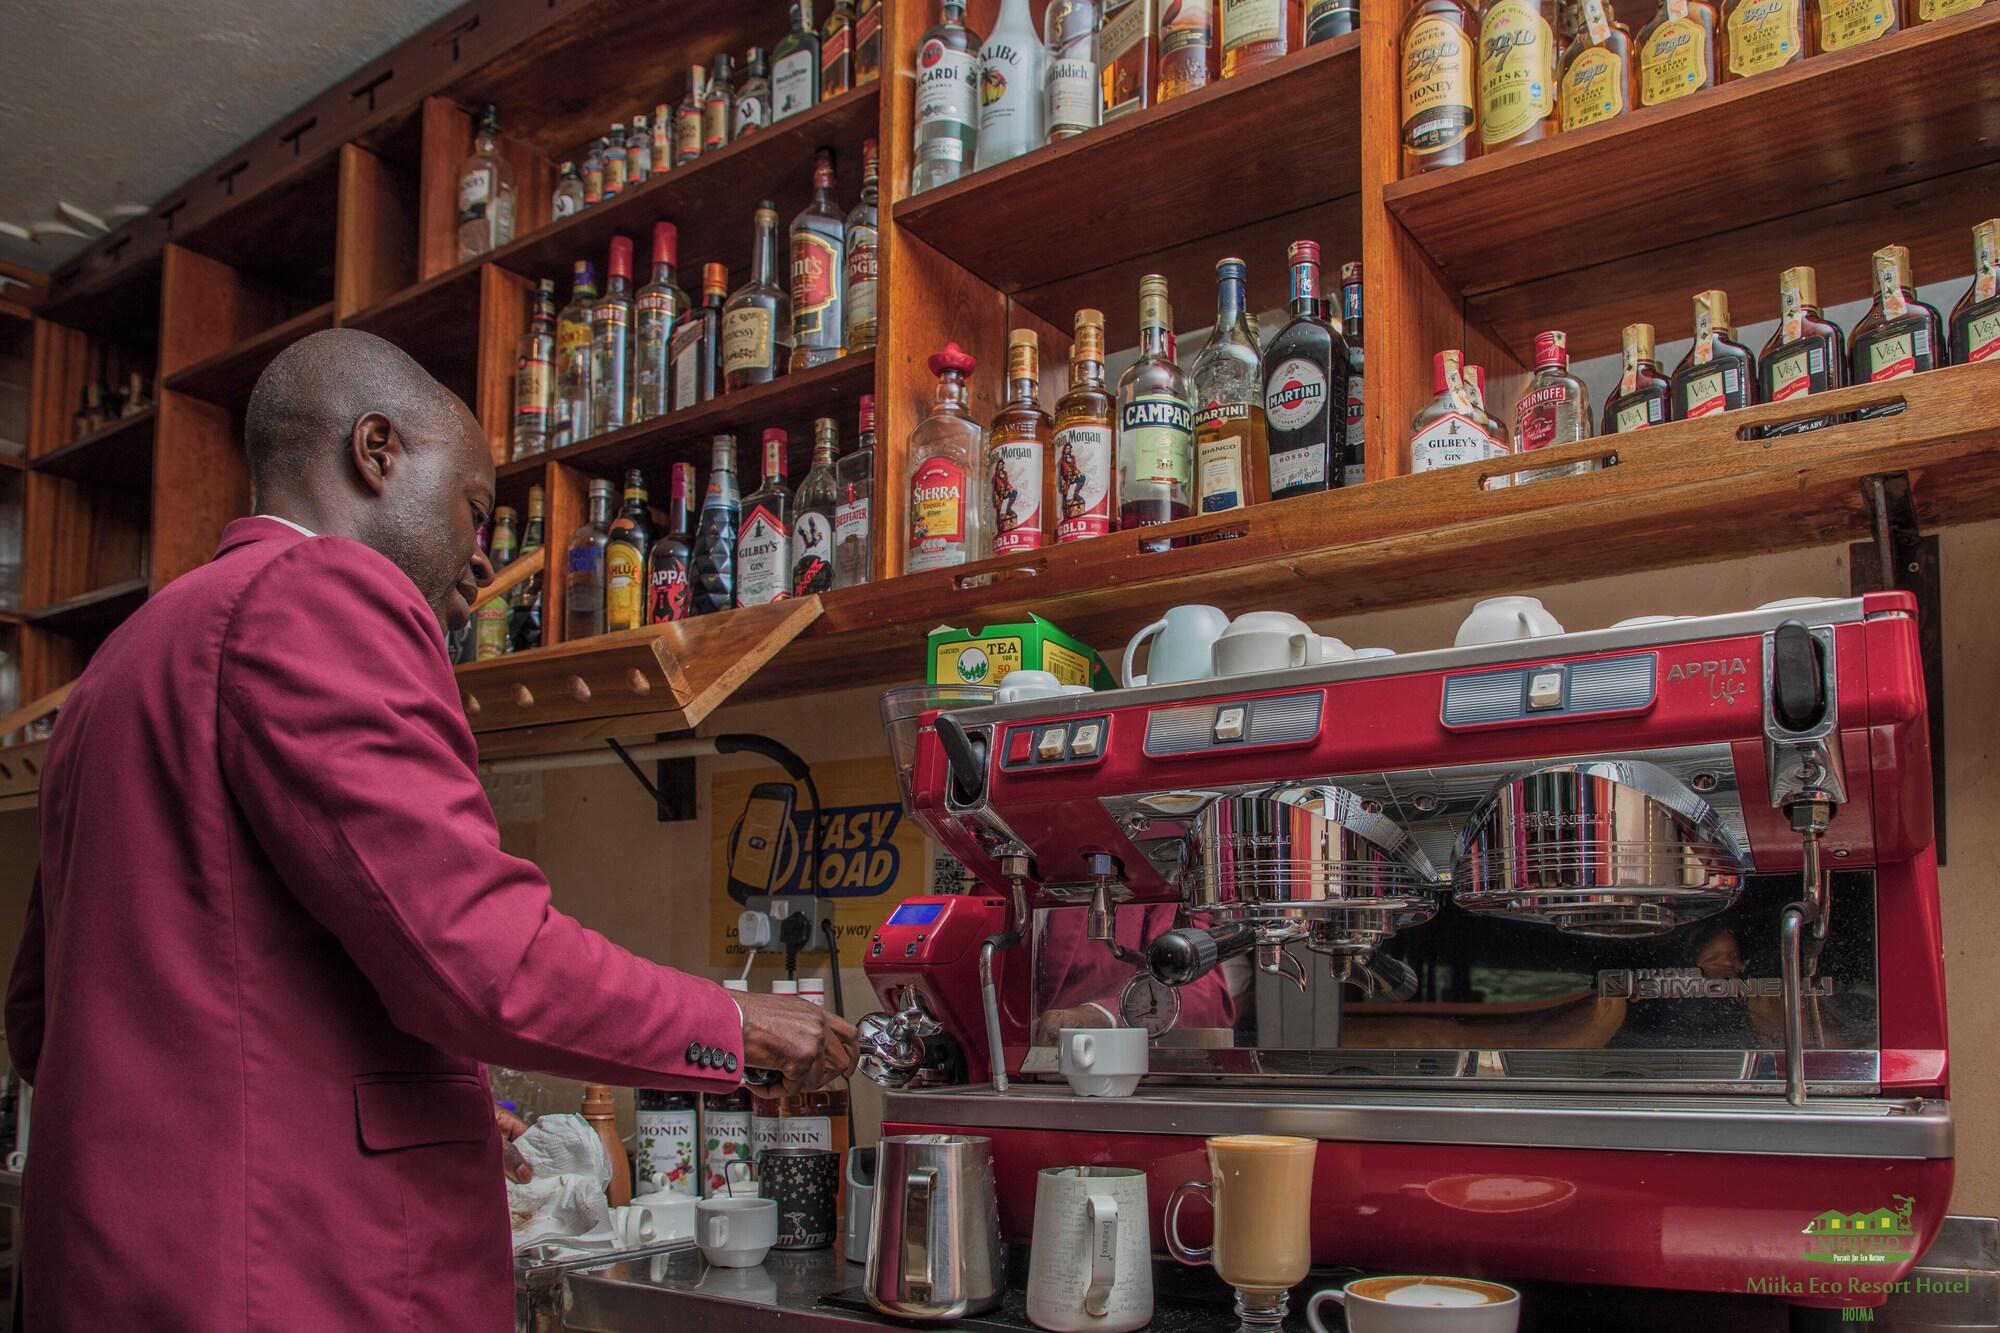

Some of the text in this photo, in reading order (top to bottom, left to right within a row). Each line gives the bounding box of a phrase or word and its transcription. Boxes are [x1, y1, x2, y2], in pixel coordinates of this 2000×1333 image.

[1482, 29, 1537, 65] BOND
[1483, 70, 1530, 92] WHISKY
[1410, 80, 1453, 104] HONEY
[1876, 341, 1906, 360] V&A
[1777, 360, 1802, 379] V&A
[1270, 384, 1320, 408] MARTINI
[1691, 379, 1717, 397] V&A
[1196, 404, 1244, 425] MARTINI
[1620, 408, 1643, 427] V&A
[1067, 430, 1101, 444] Morgan
[1428, 437, 1477, 449] GILBEY'S
[1000, 446, 1032, 459] Morgan
[1202, 444, 1236, 455] BIANCO
[1280, 452, 1310, 463] ROSSO
[914, 485, 960, 504] SIERRA
[836, 507, 867, 528] BEEFEATER
[739, 540, 778, 558] GILBEY'S
[750, 562, 764, 571] GIN
[987, 642, 1017, 655] TEA
[997, 664, 1010, 673] 50
[1667, 658, 1747, 681] APPIA
[847, 925, 871, 938] way
